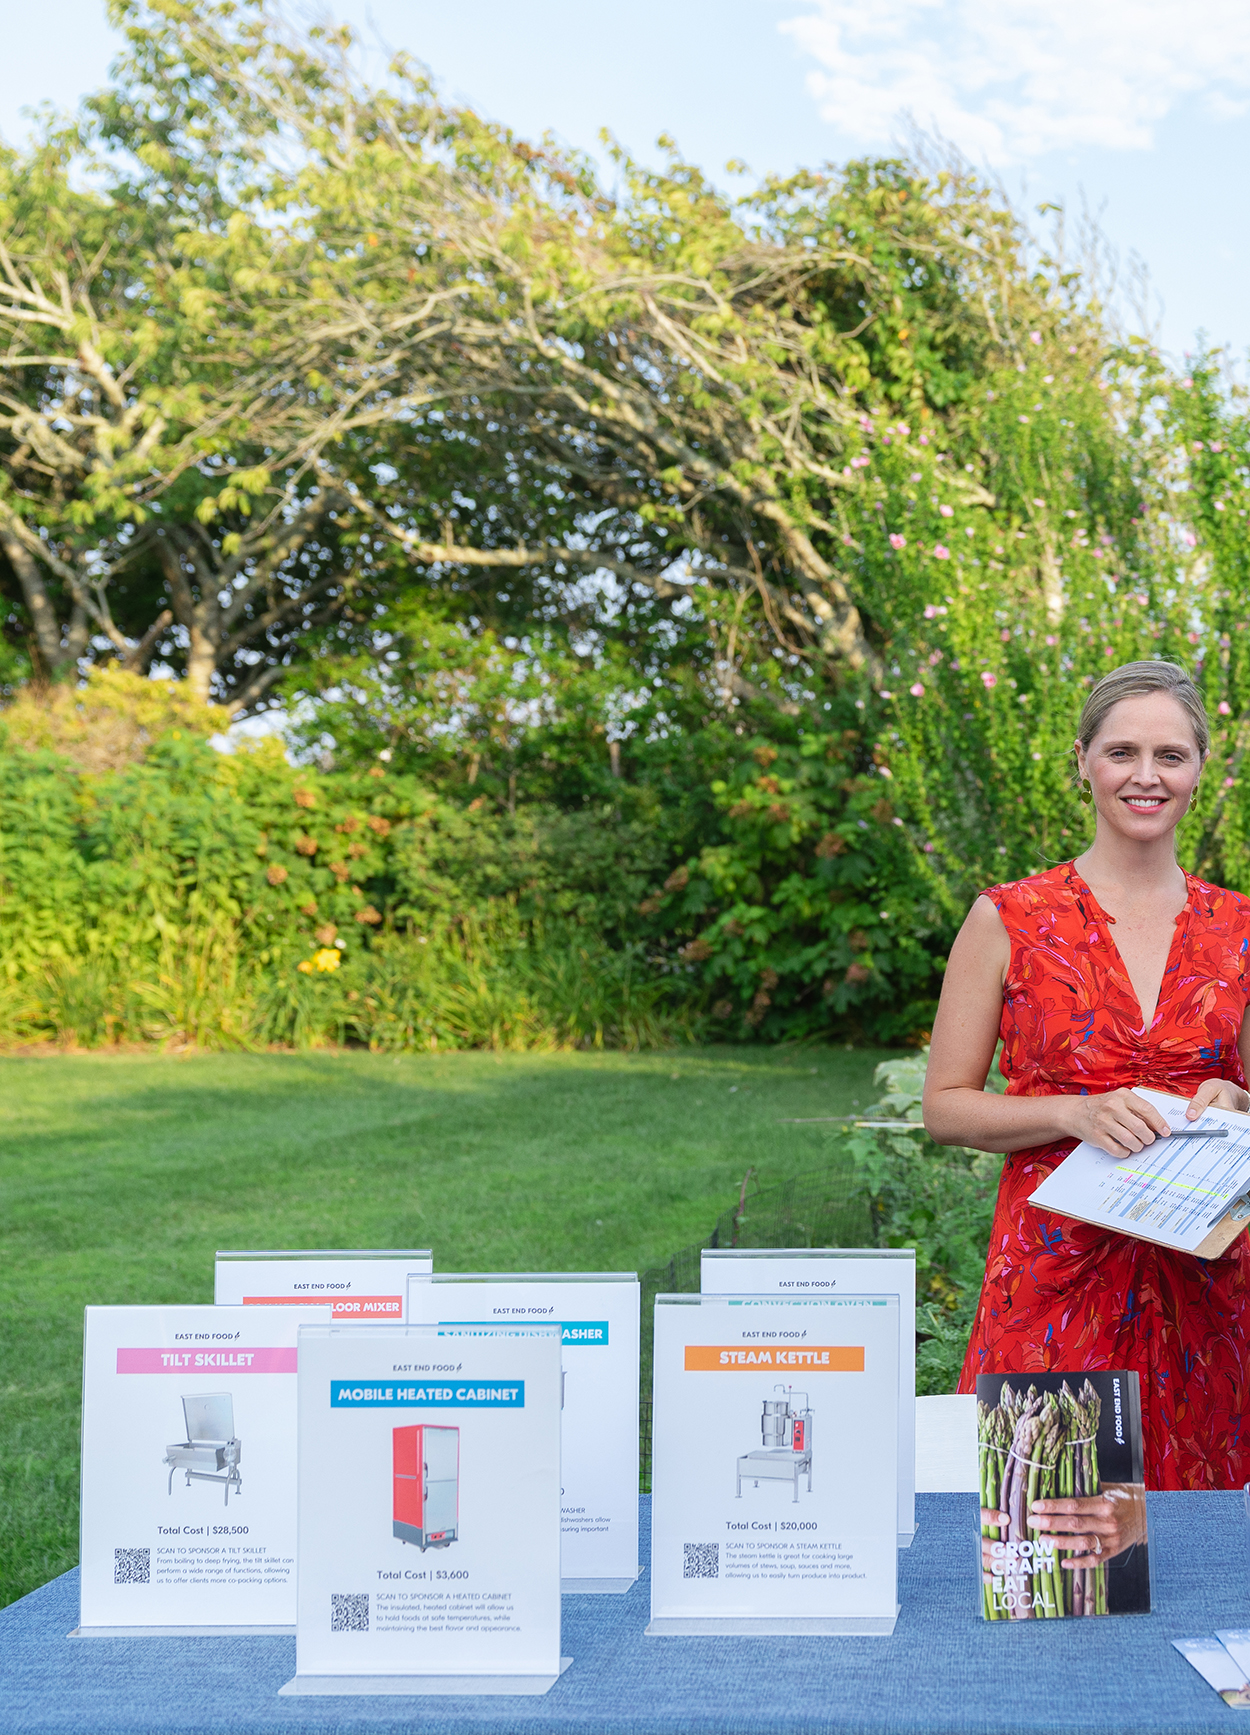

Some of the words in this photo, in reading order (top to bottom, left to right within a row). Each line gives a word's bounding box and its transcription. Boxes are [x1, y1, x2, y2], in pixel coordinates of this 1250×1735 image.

[331, 1302, 361, 1312] LOOR
[363, 1302, 400, 1312] MIXER
[161, 1353, 192, 1367] TILT
[195, 1353, 255, 1367] SKILLET
[719, 1351, 773, 1365] STEAM
[776, 1351, 830, 1365] KETTLE
[392, 1364, 412, 1372] EAST
[414, 1364, 431, 1372] END
[432, 1364, 455, 1372] FOOD
[1113, 1378, 1121, 1396] EAST
[338, 1388, 394, 1401] MOBILE
[397, 1388, 453, 1401] HEATED
[456, 1388, 519, 1401] CABINET
[1115, 1415, 1123, 1437] FOOD
[157, 1526, 181, 1535] Total
[183, 1526, 204, 1535] Cost
[212, 1526, 249, 1535] $28,500
[726, 1521, 749, 1530] Total
[751, 1521, 772, 1530] Cost
[780, 1522, 818, 1531] $20,000
[157, 1547, 176, 1555] SCAN
[177, 1547, 187, 1555] TO
[188, 1547, 220, 1555] SPONSOR
[726, 1542, 745, 1550] SCAN
[757, 1542, 788, 1550] SPONSOR
[990, 1540, 1055, 1558] GROW
[991, 1557, 1055, 1575] CRAFT
[377, 1570, 402, 1580] Total
[404, 1570, 427, 1580] Cost
[436, 1570, 469, 1581] $3,600
[992, 1575, 1028, 1592] EAT
[376, 1593, 396, 1601] SCAN
[398, 1593, 409, 1601] TO
[410, 1593, 444, 1601] SPONSOR
[452, 1593, 481, 1601] HEATED
[482, 1593, 512, 1601] CABINET
[993, 1591, 1055, 1610] LOCAL
